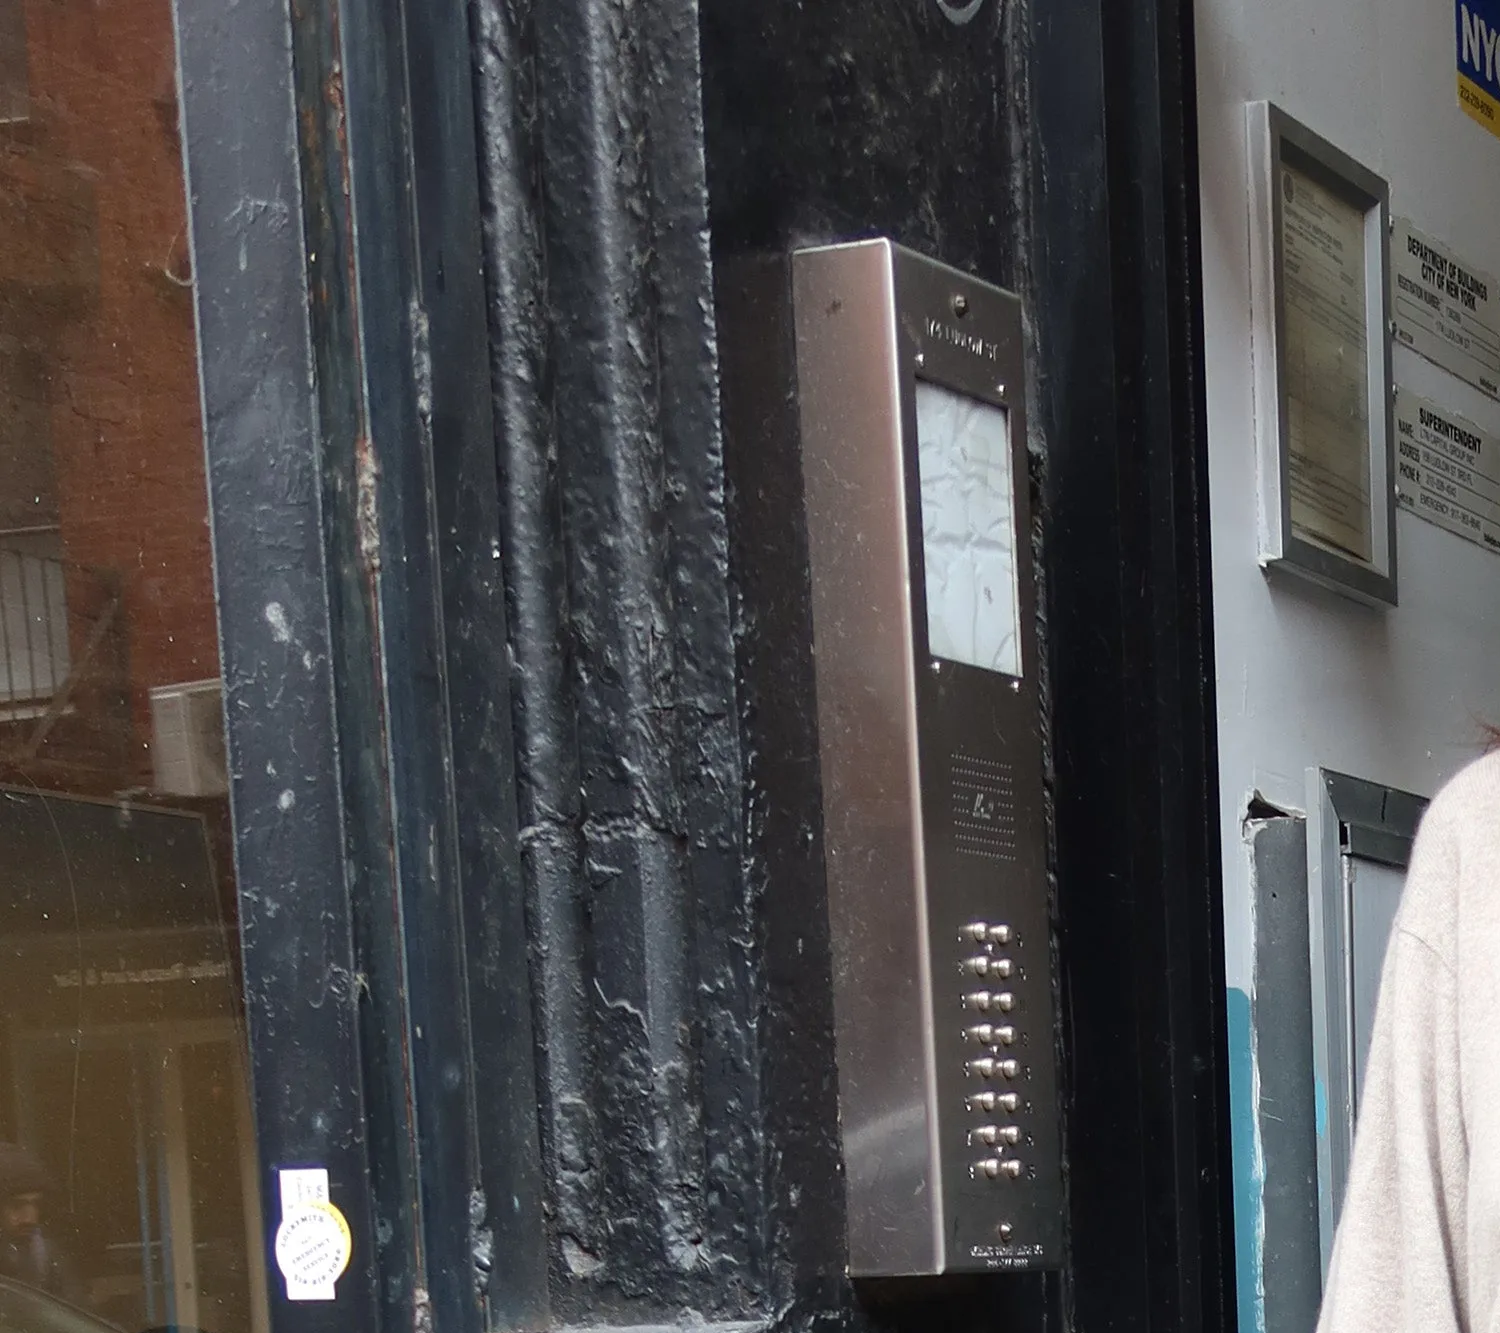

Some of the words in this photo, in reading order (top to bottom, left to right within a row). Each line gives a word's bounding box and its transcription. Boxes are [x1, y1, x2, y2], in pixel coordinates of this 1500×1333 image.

[1407, 234, 1447, 277] DEPARTMENT
[1447, 261, 1457, 281] OF
[1457, 266, 1487, 303] BUILDINGS
[1421, 261, 1436, 287] CITY
[1436, 271, 1446, 292] OF
[1446, 278, 1460, 301] NEW
[1460, 285, 1477, 312] YORK
[1419, 407, 1482, 455] SUPERINTENDENT
[281, 1215, 325, 1248] LOCKSMITH
